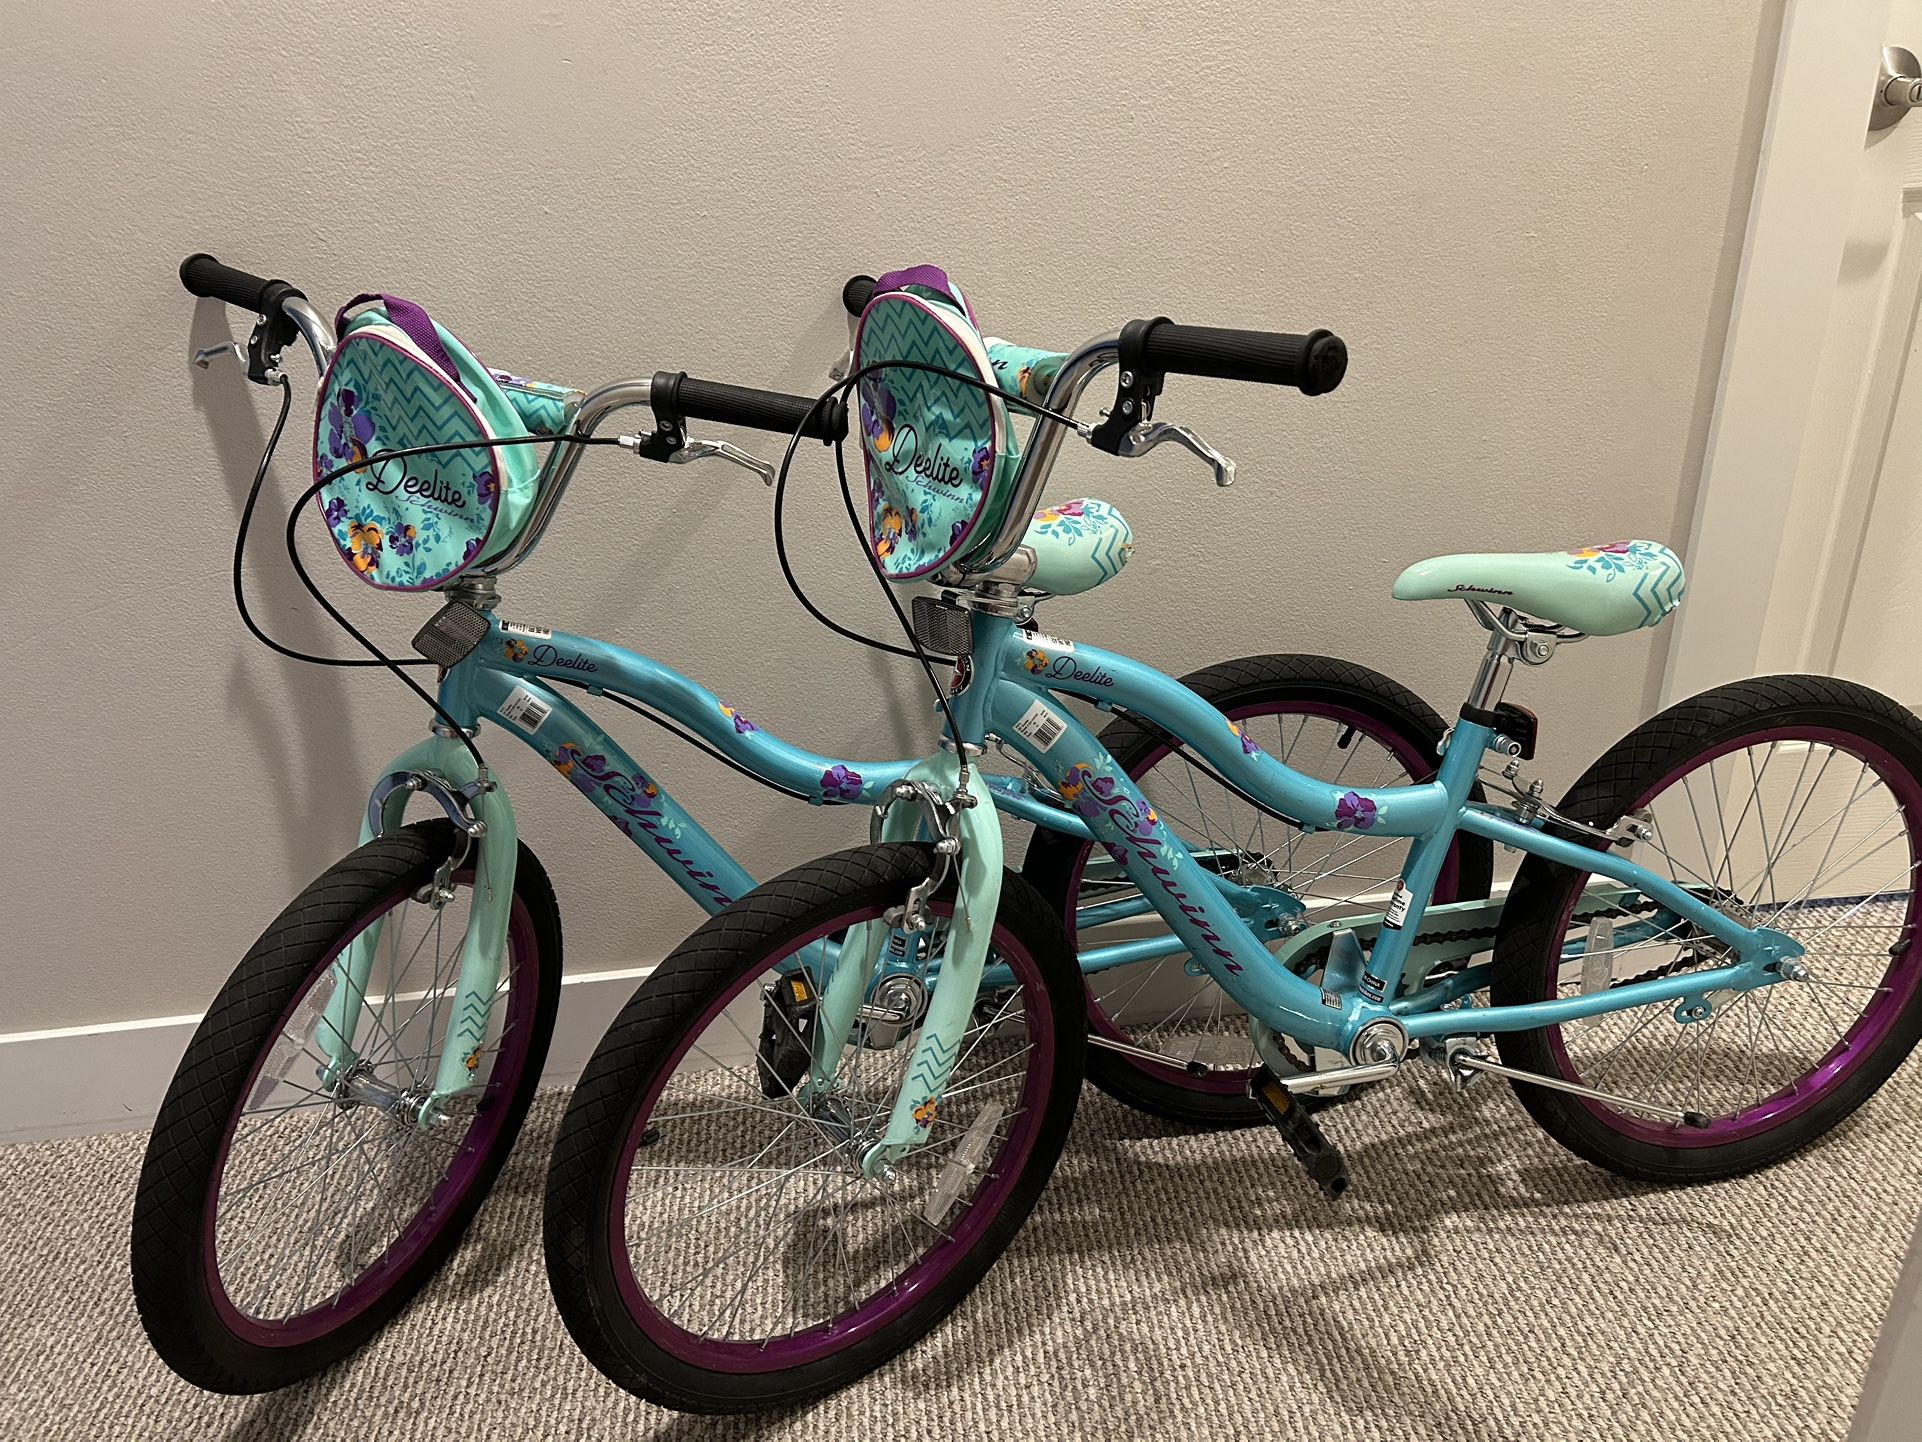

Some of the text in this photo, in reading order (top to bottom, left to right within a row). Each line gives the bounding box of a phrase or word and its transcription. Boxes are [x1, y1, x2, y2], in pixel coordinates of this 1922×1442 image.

[884, 423, 963, 488] Deelite
[366, 448, 466, 508] Deelite
[906, 475, 966, 504] Schwinn
[395, 495, 475, 523] Schwinn
[1448, 584, 1512, 595] Schwinn
[527, 644, 597, 673] Deelite
[1045, 655, 1114, 687] Deelite
[569, 748, 735, 908] Schwin
[1081, 769, 1244, 977] Schwinn
